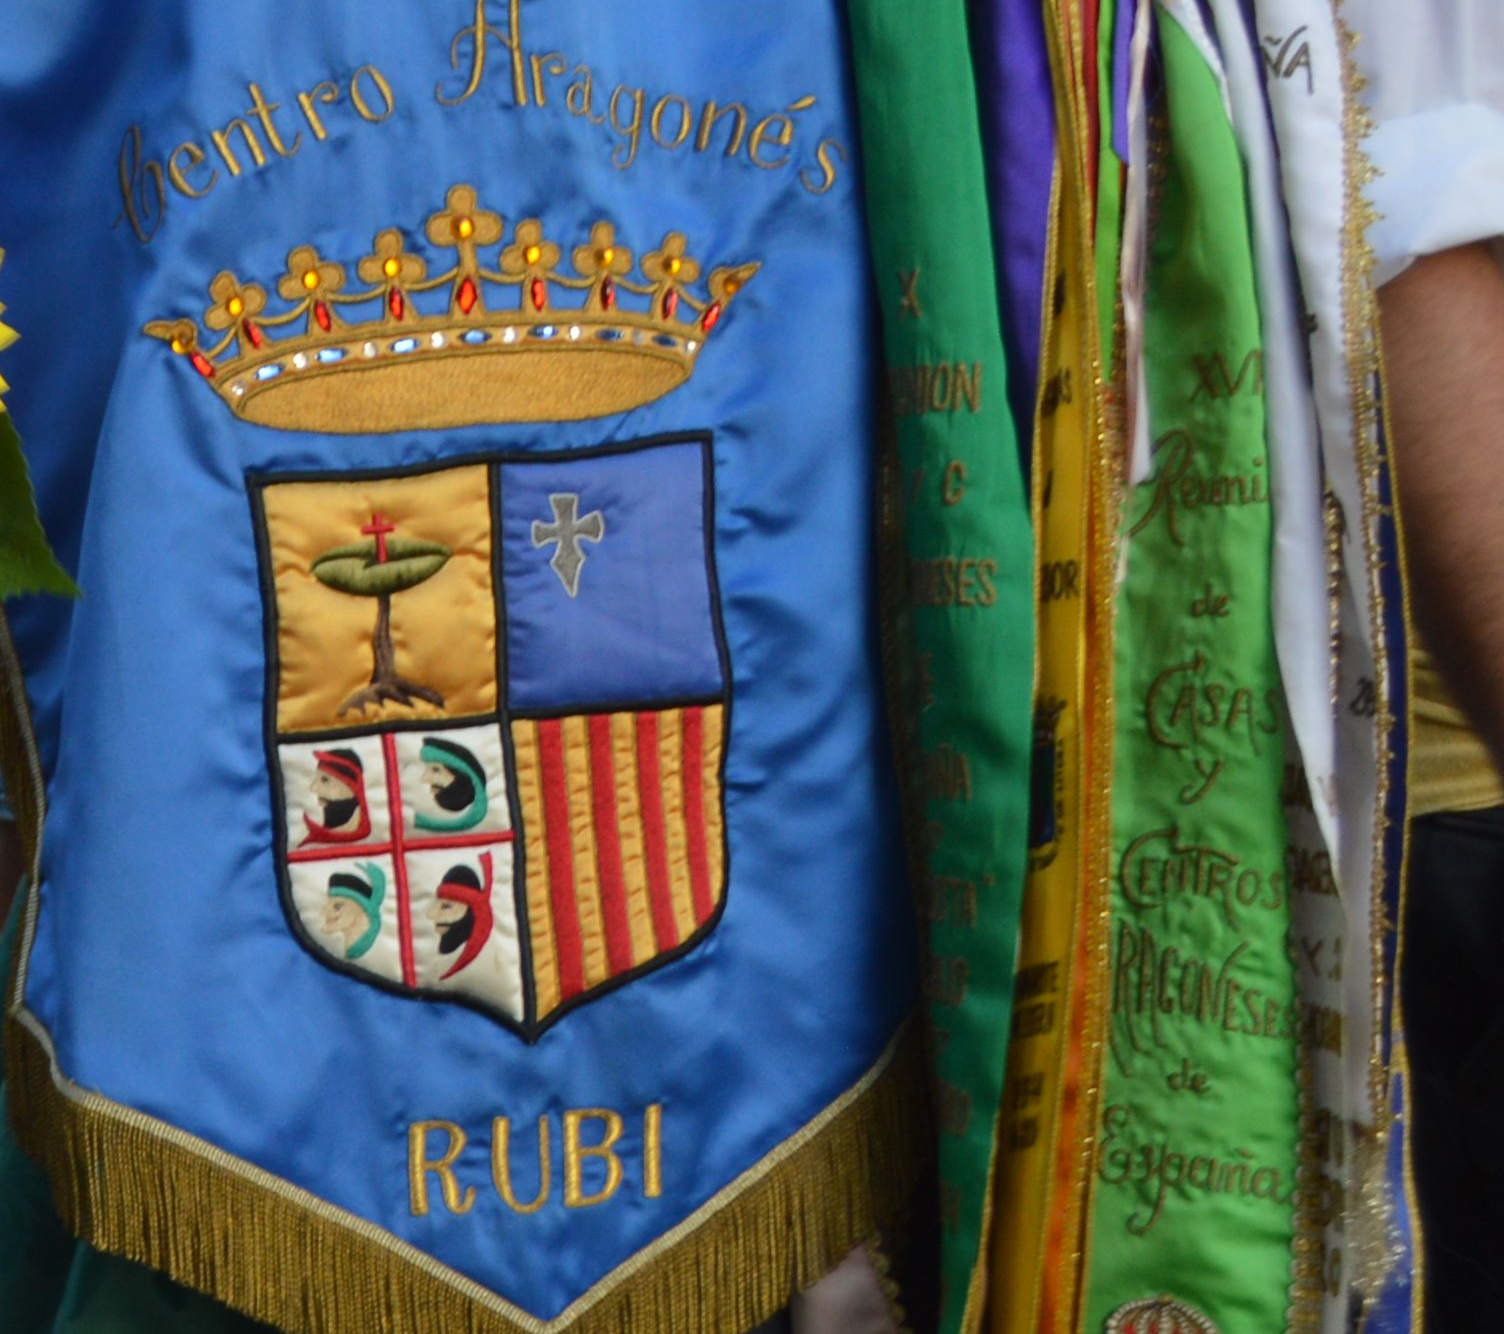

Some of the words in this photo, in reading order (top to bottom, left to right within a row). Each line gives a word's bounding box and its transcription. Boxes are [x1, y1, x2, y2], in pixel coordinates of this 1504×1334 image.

[113, 65, 394, 244] Centro
[1127, 426, 1269, 547] Reuni
[1190, 581, 1230, 618] de
[1166, 1057, 1211, 1095] de
[408, 1103, 664, 1216] RUBI
[1099, 1103, 1289, 1236] España
